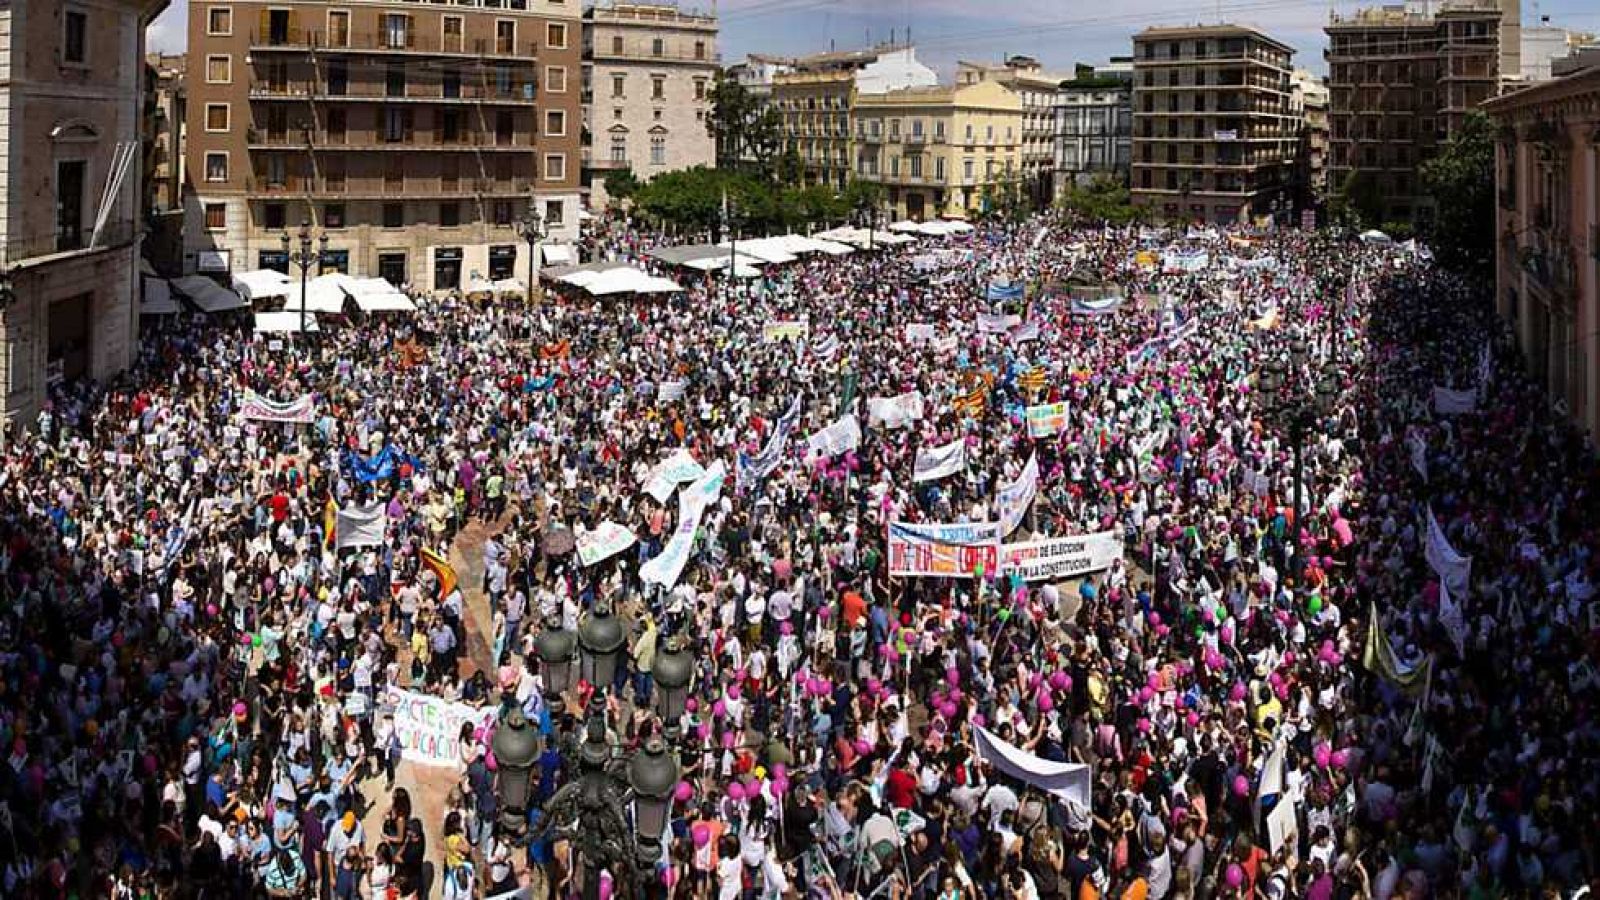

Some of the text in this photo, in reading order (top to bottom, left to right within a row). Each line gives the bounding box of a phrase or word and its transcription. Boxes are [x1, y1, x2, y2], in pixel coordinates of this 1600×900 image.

[1039, 545, 1049, 558] DE
[1018, 566, 1029, 577] EN
[1029, 565, 1039, 577] LA
